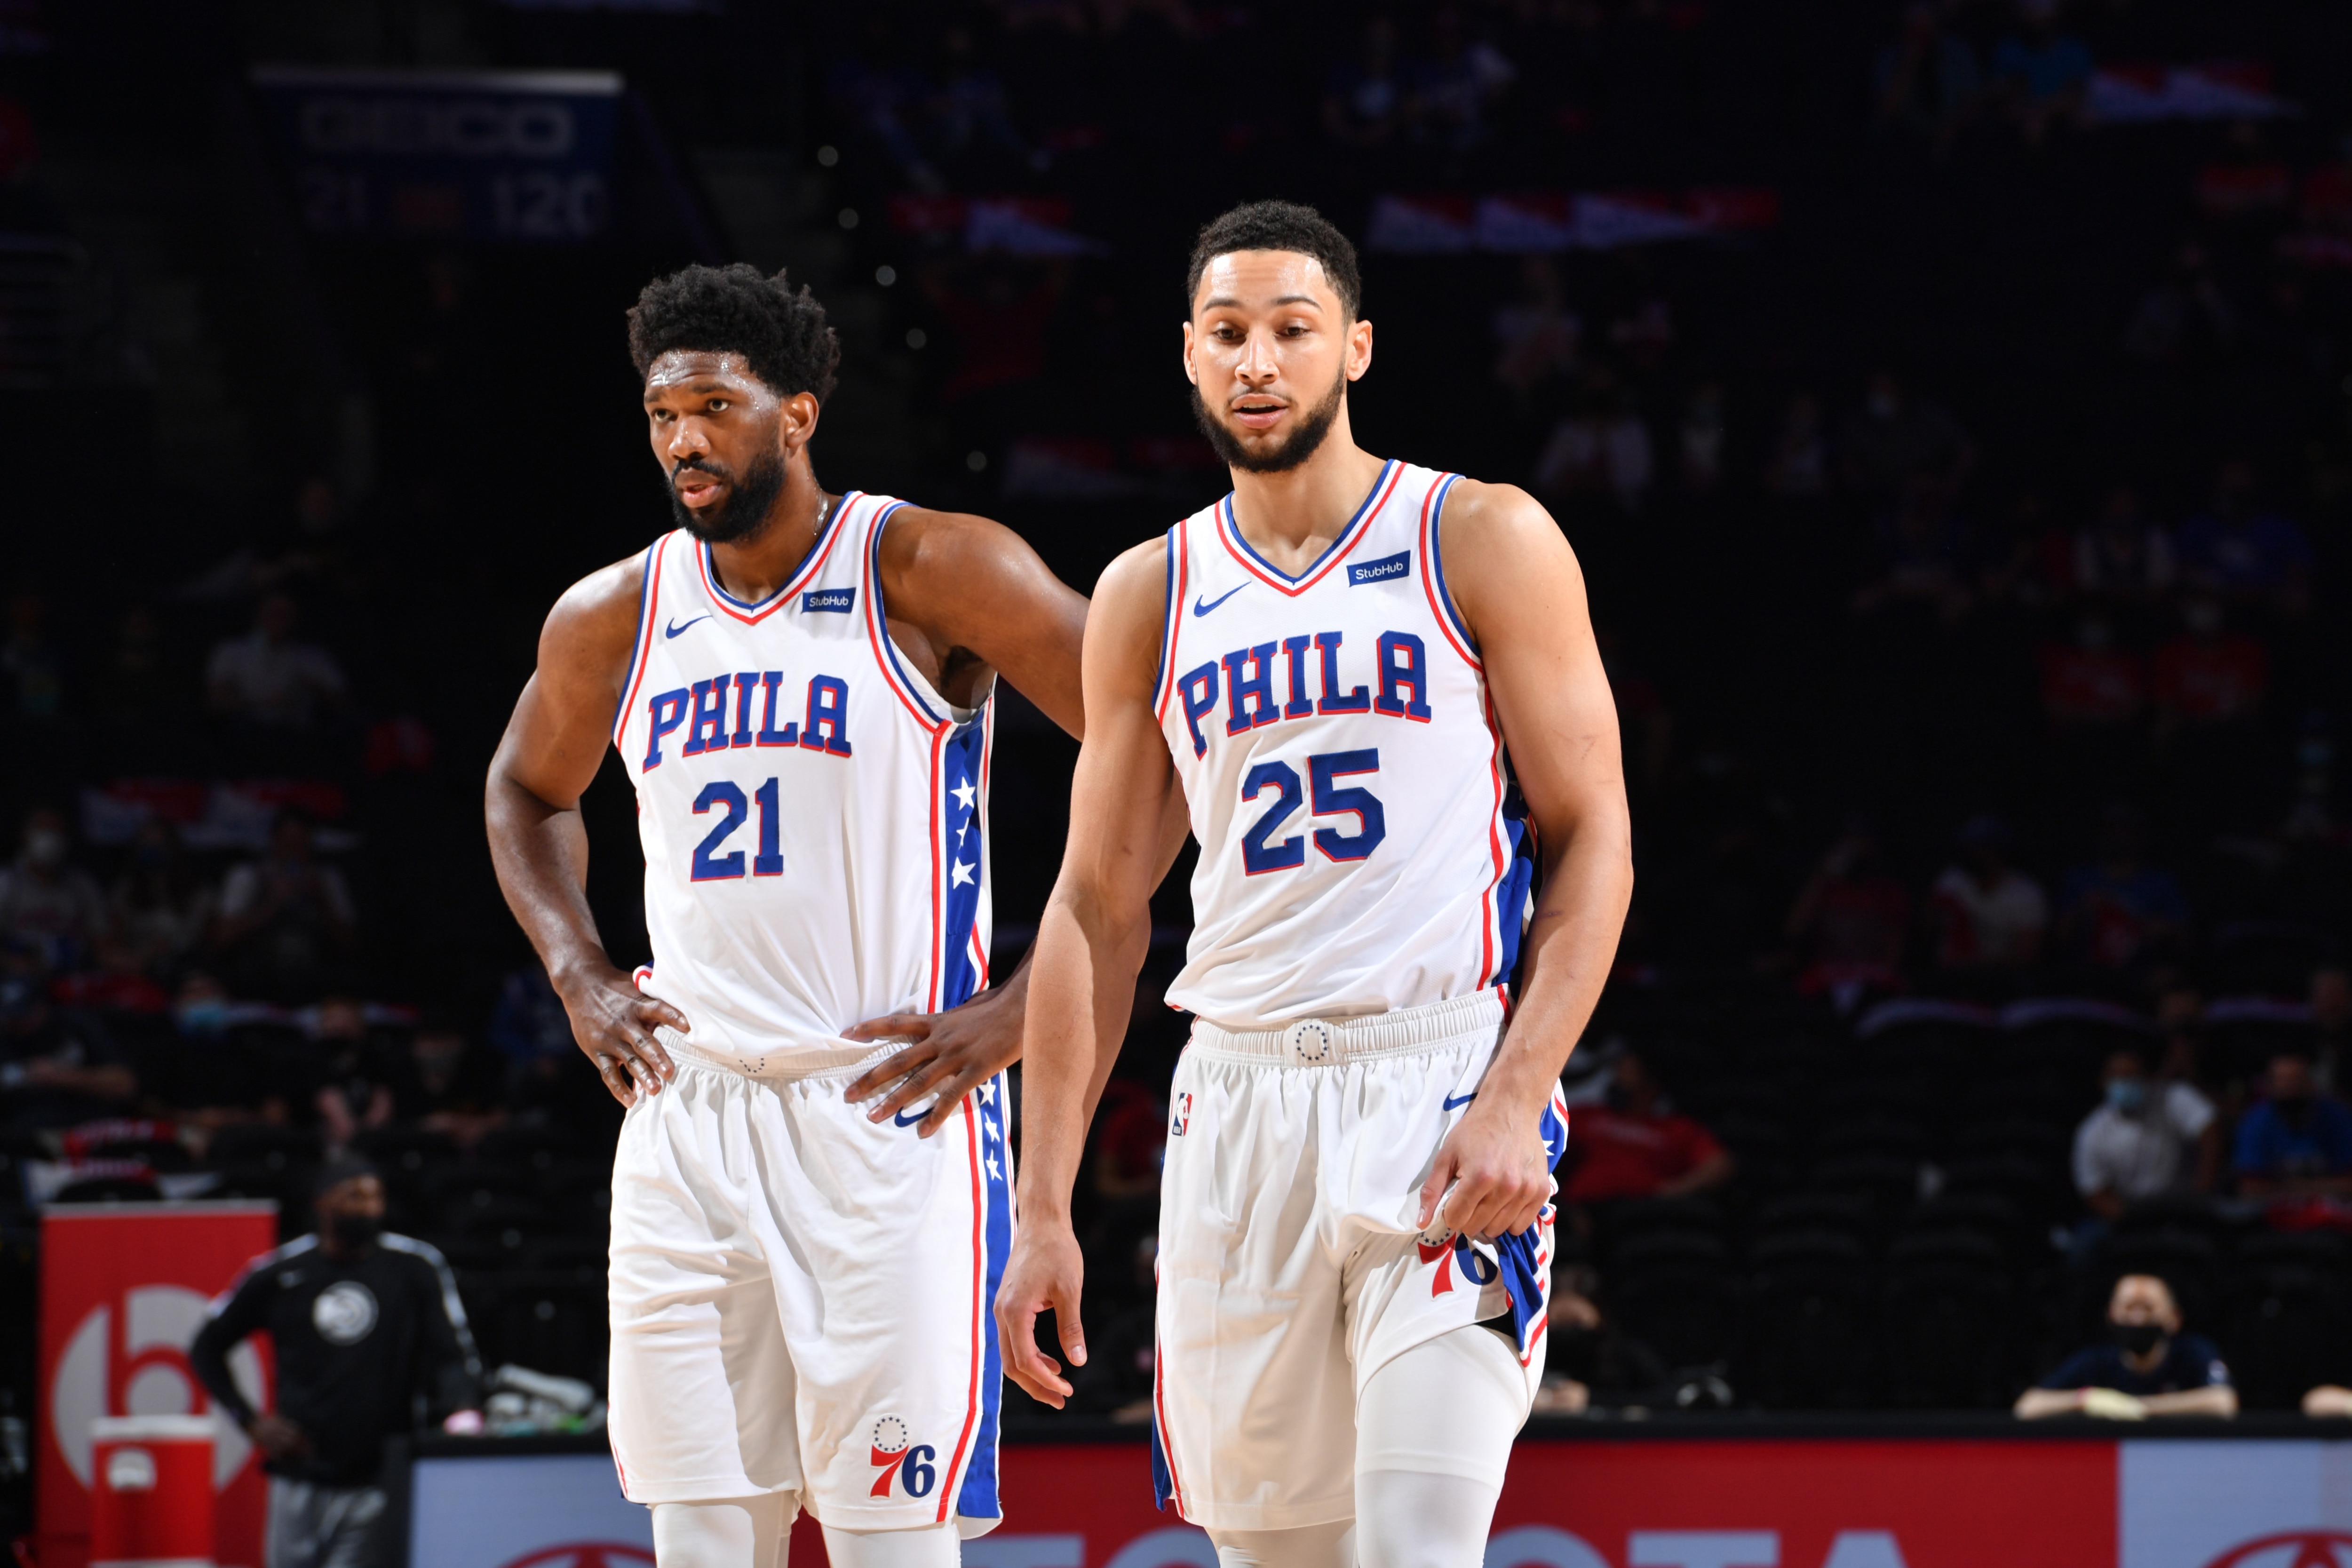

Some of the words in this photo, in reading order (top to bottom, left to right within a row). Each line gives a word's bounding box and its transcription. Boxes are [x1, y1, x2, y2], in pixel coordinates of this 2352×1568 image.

[492, 170, 608, 237] 120
[809, 596, 849, 607] StubHub
[1356, 562, 1403, 580] StubHub
[643, 671, 852, 774] PHILA
[1177, 630, 1431, 762] PHILA
[690, 777, 783, 882] 21
[1241, 748, 1386, 876] 25
[870, 1444, 936, 1498] 76
